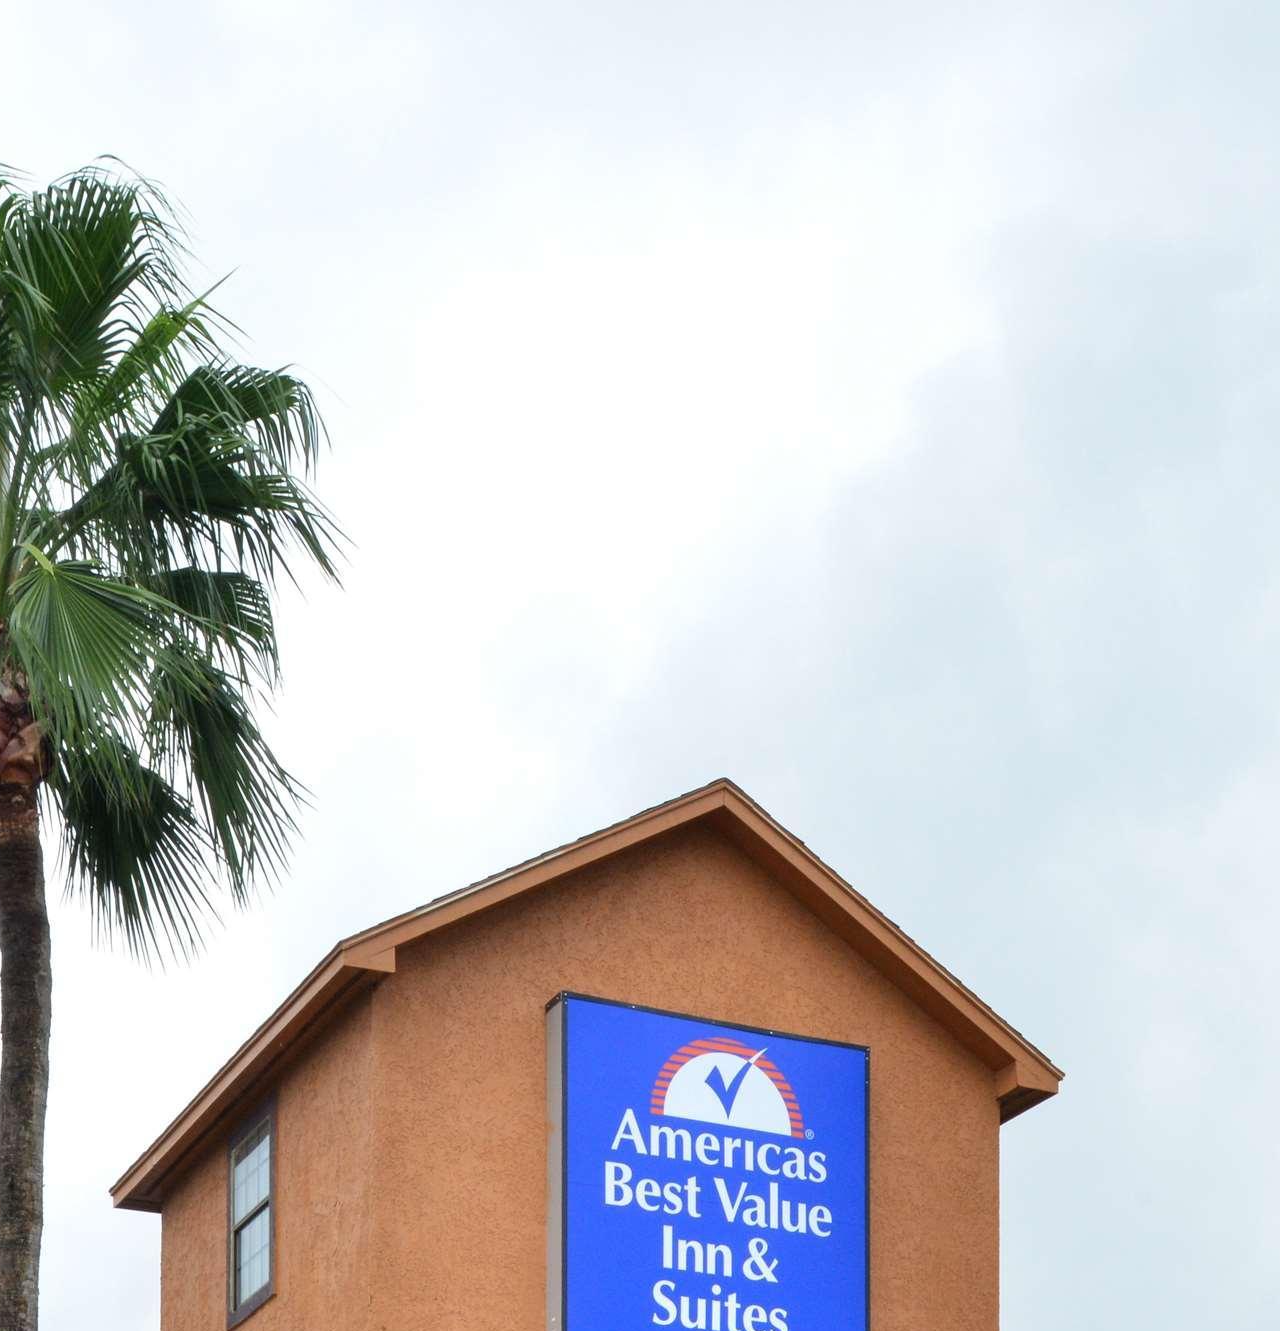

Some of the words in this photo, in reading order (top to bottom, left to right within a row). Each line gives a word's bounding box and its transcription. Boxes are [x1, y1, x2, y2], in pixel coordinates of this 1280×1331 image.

[611, 1108, 827, 1183] Americas
[604, 1161, 701, 1218] Best
[714, 1177, 832, 1238] Value
[662, 1225, 732, 1277] Inn
[742, 1237, 779, 1284] &
